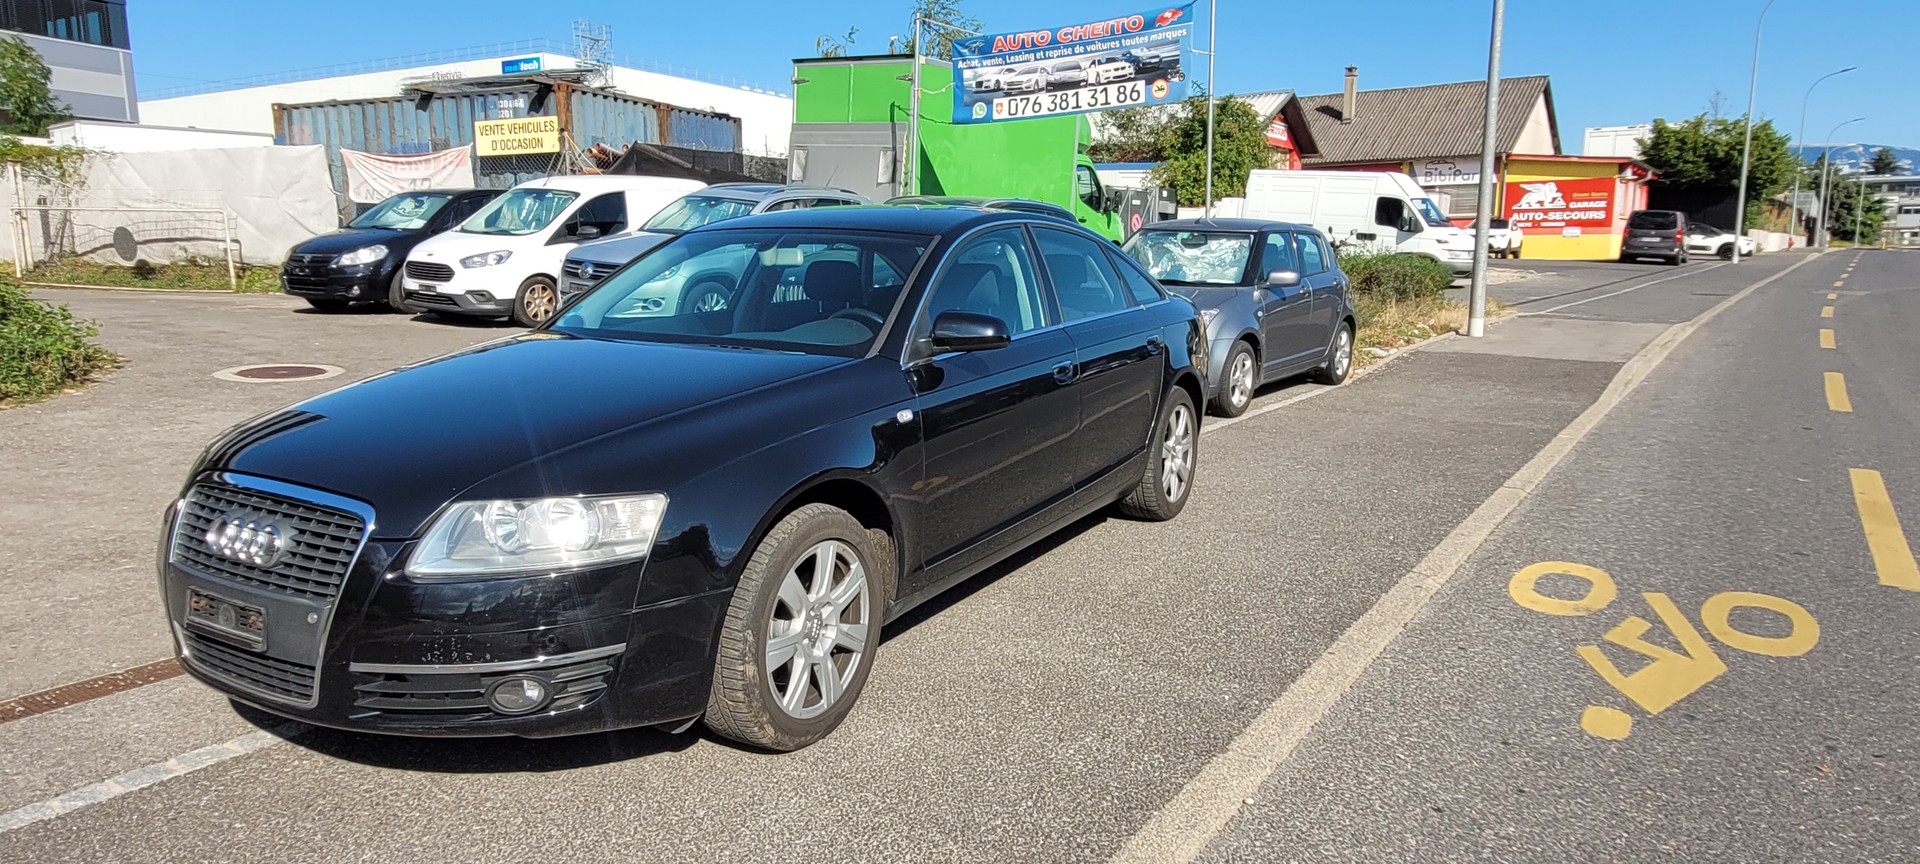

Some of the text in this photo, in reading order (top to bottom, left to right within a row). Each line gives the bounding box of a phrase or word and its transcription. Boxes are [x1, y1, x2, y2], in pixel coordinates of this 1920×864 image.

[992, 14, 1144, 53] AUTO CHEITO
[957, 28, 1187, 69] Achat, vente, Leasing et reprise de voitures toutes marques
[1008, 82, 1141, 117] 076 381 31 86
[478, 120, 555, 136] VENTE VEHICULES
[491, 137, 544, 151] D'OCCASION
[1424, 168, 1478, 183] BibiPar
[1569, 201, 1607, 209] GARAGE
[1512, 210, 1606, 221] AUTO-SECOURS
